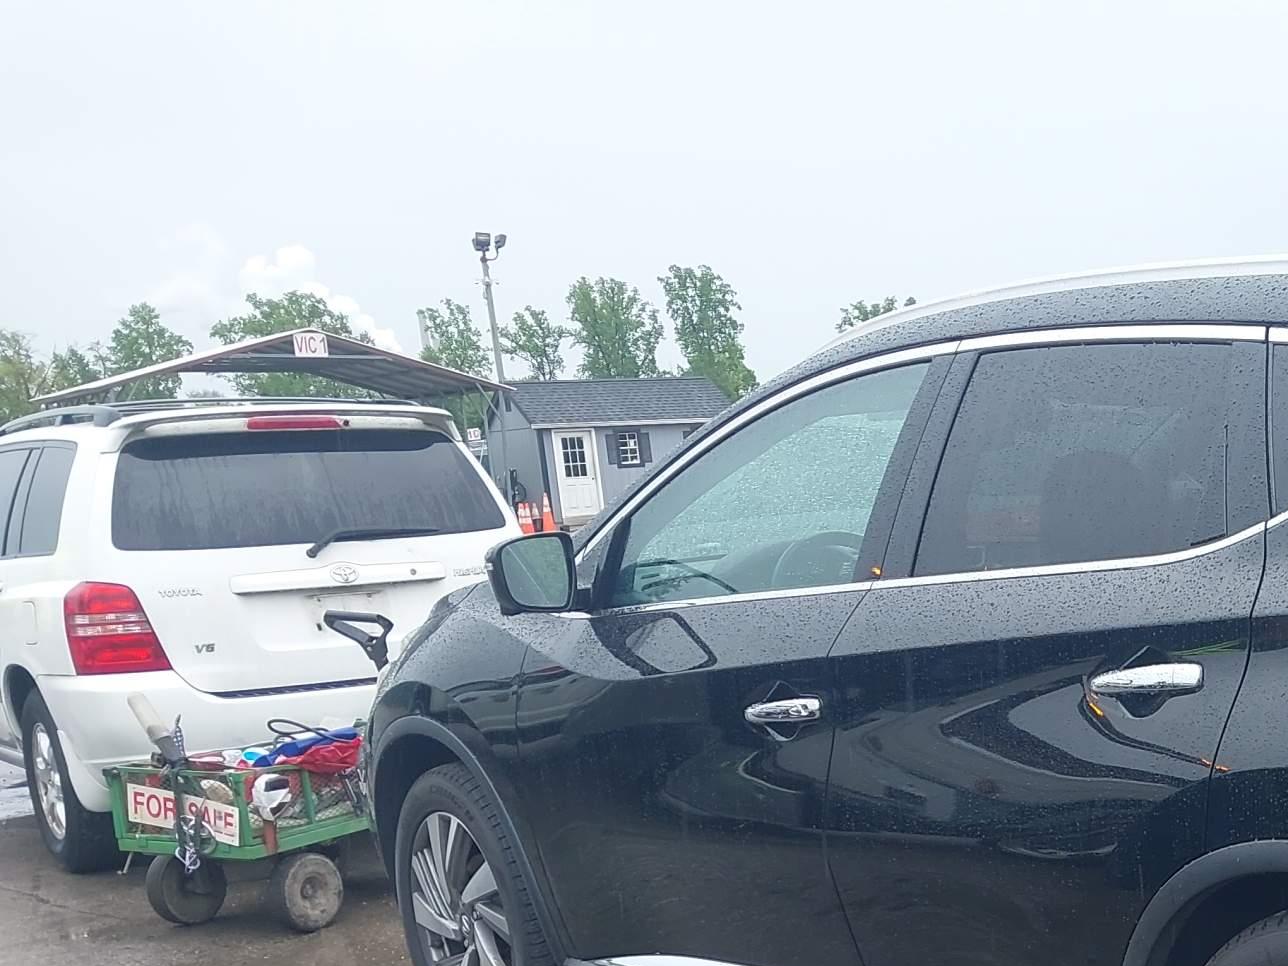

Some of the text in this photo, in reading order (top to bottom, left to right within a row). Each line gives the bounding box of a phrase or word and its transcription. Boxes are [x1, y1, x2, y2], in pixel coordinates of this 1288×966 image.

[294, 335, 327, 353] VIC 1
[158, 588, 203, 598] TOYOTA
[195, 643, 215, 654] V6
[133, 791, 177, 819] FOR
